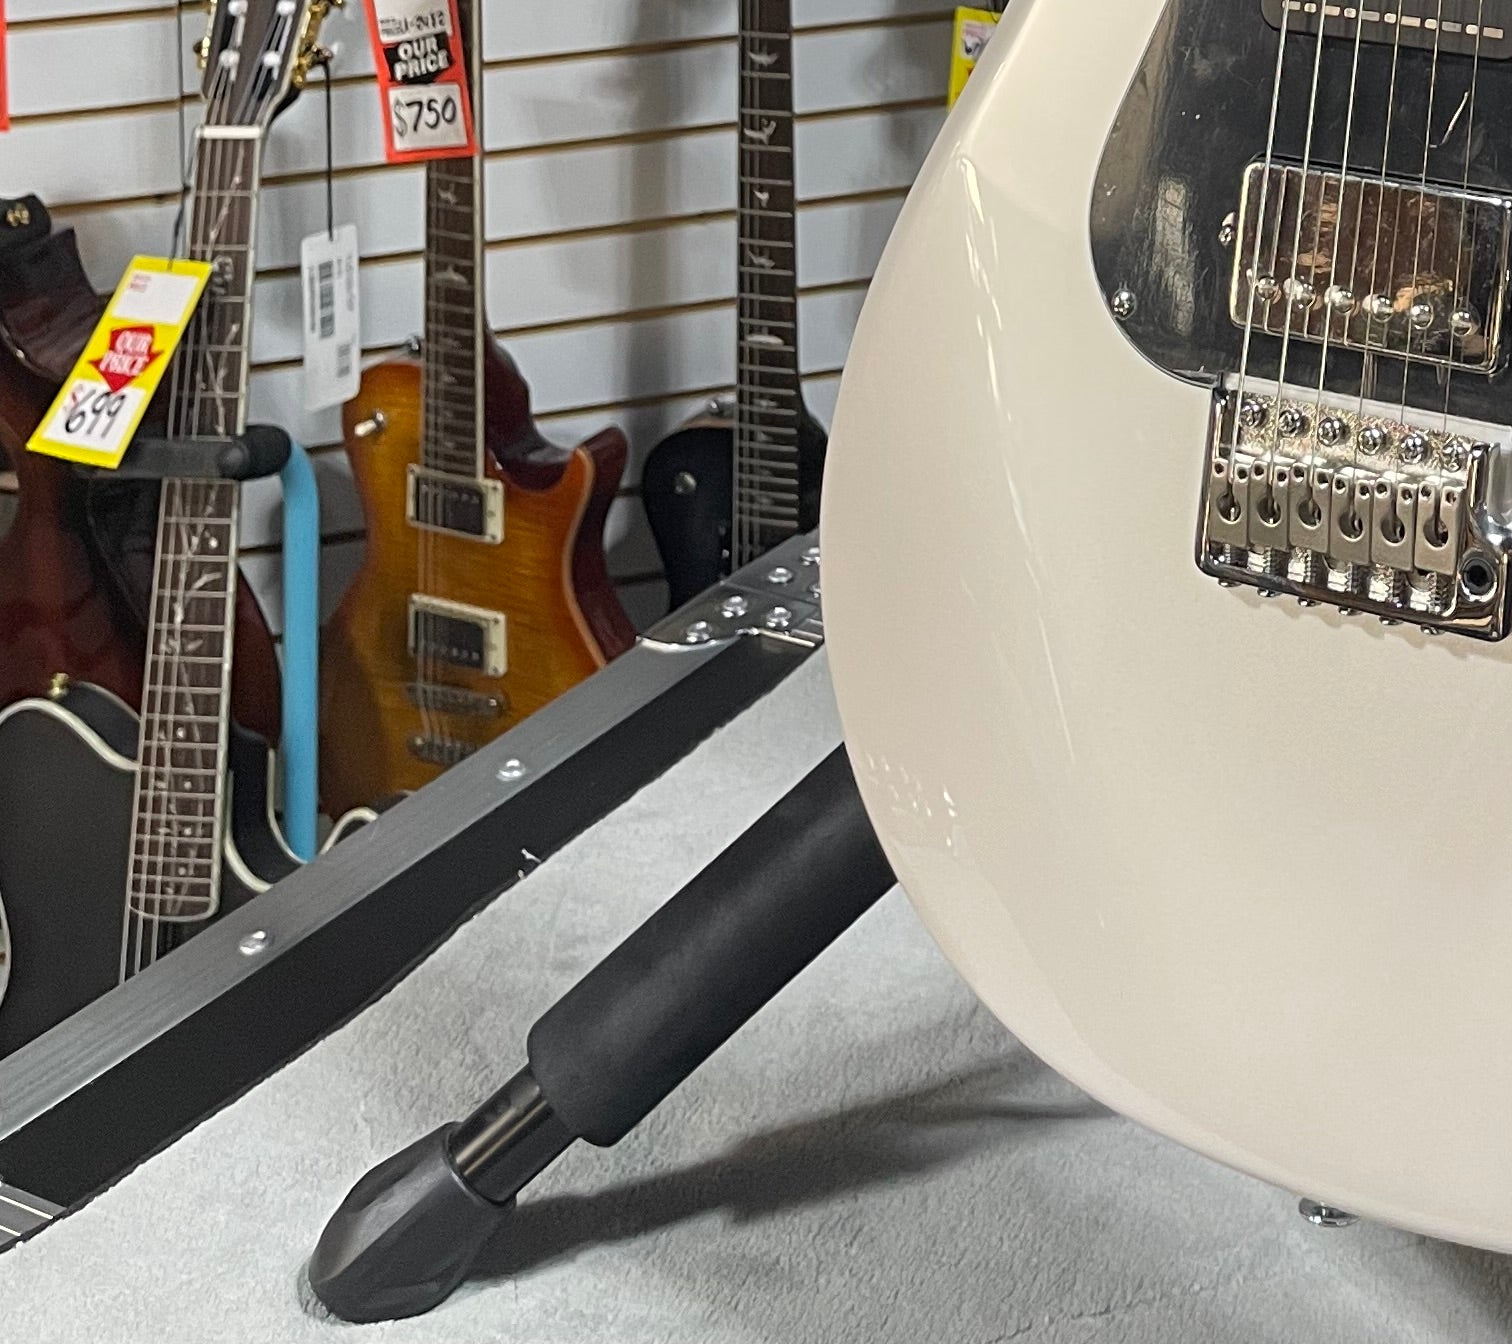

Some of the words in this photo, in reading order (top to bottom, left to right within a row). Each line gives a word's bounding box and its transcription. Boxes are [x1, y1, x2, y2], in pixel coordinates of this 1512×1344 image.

[397, 33, 438, 61] OUR
[393, 48, 450, 81] PRICE
[393, 95, 457, 139] $750
